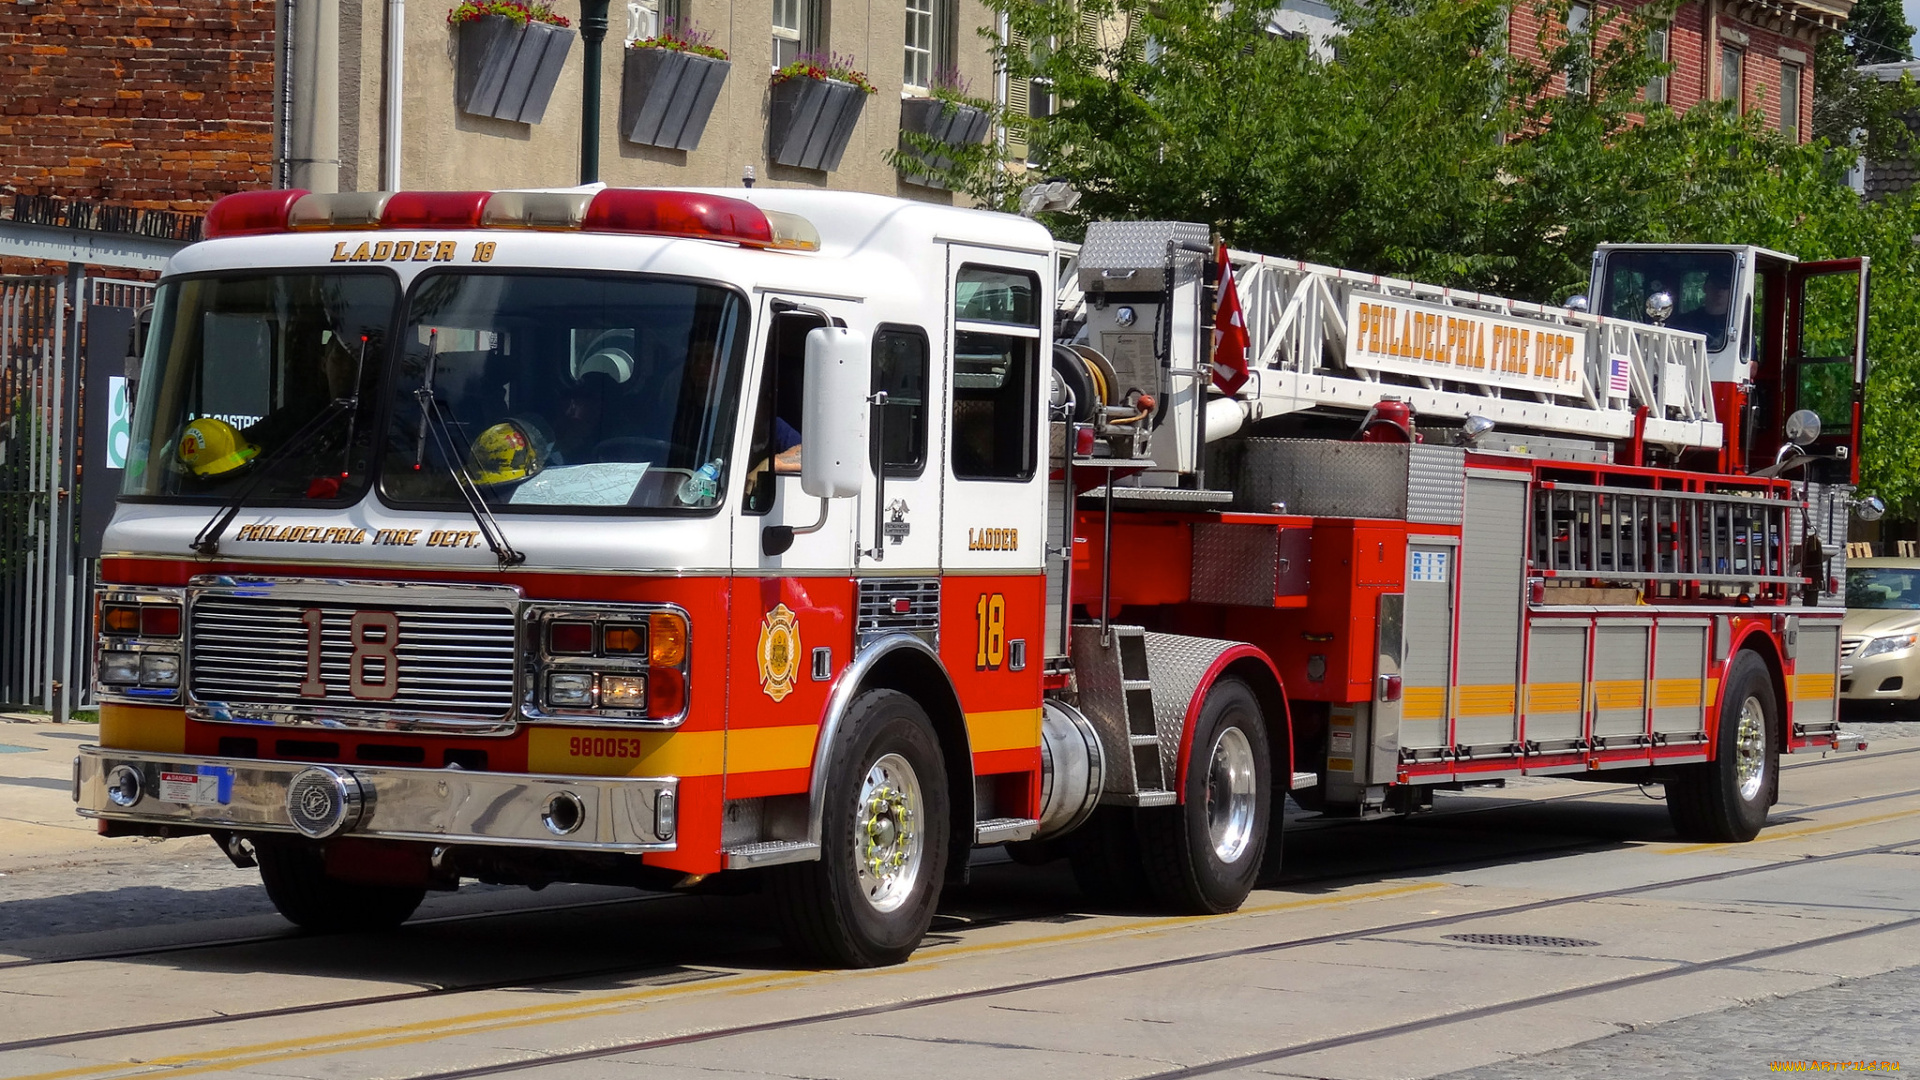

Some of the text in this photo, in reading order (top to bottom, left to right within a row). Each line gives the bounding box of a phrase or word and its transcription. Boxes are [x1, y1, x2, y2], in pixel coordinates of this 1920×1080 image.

[330, 241, 497, 263] LADDER 18
[1356, 302, 1578, 383] PHILADELPHIA FIRE DEPT.
[182, 437, 195, 456] 12
[236, 524, 481, 549] PHILADELPHIA FIRE DEPT.
[968, 527, 1019, 551] LADDER
[976, 593, 1005, 671] 18
[300, 608, 399, 701] 18
[569, 736, 641, 758] 980053
